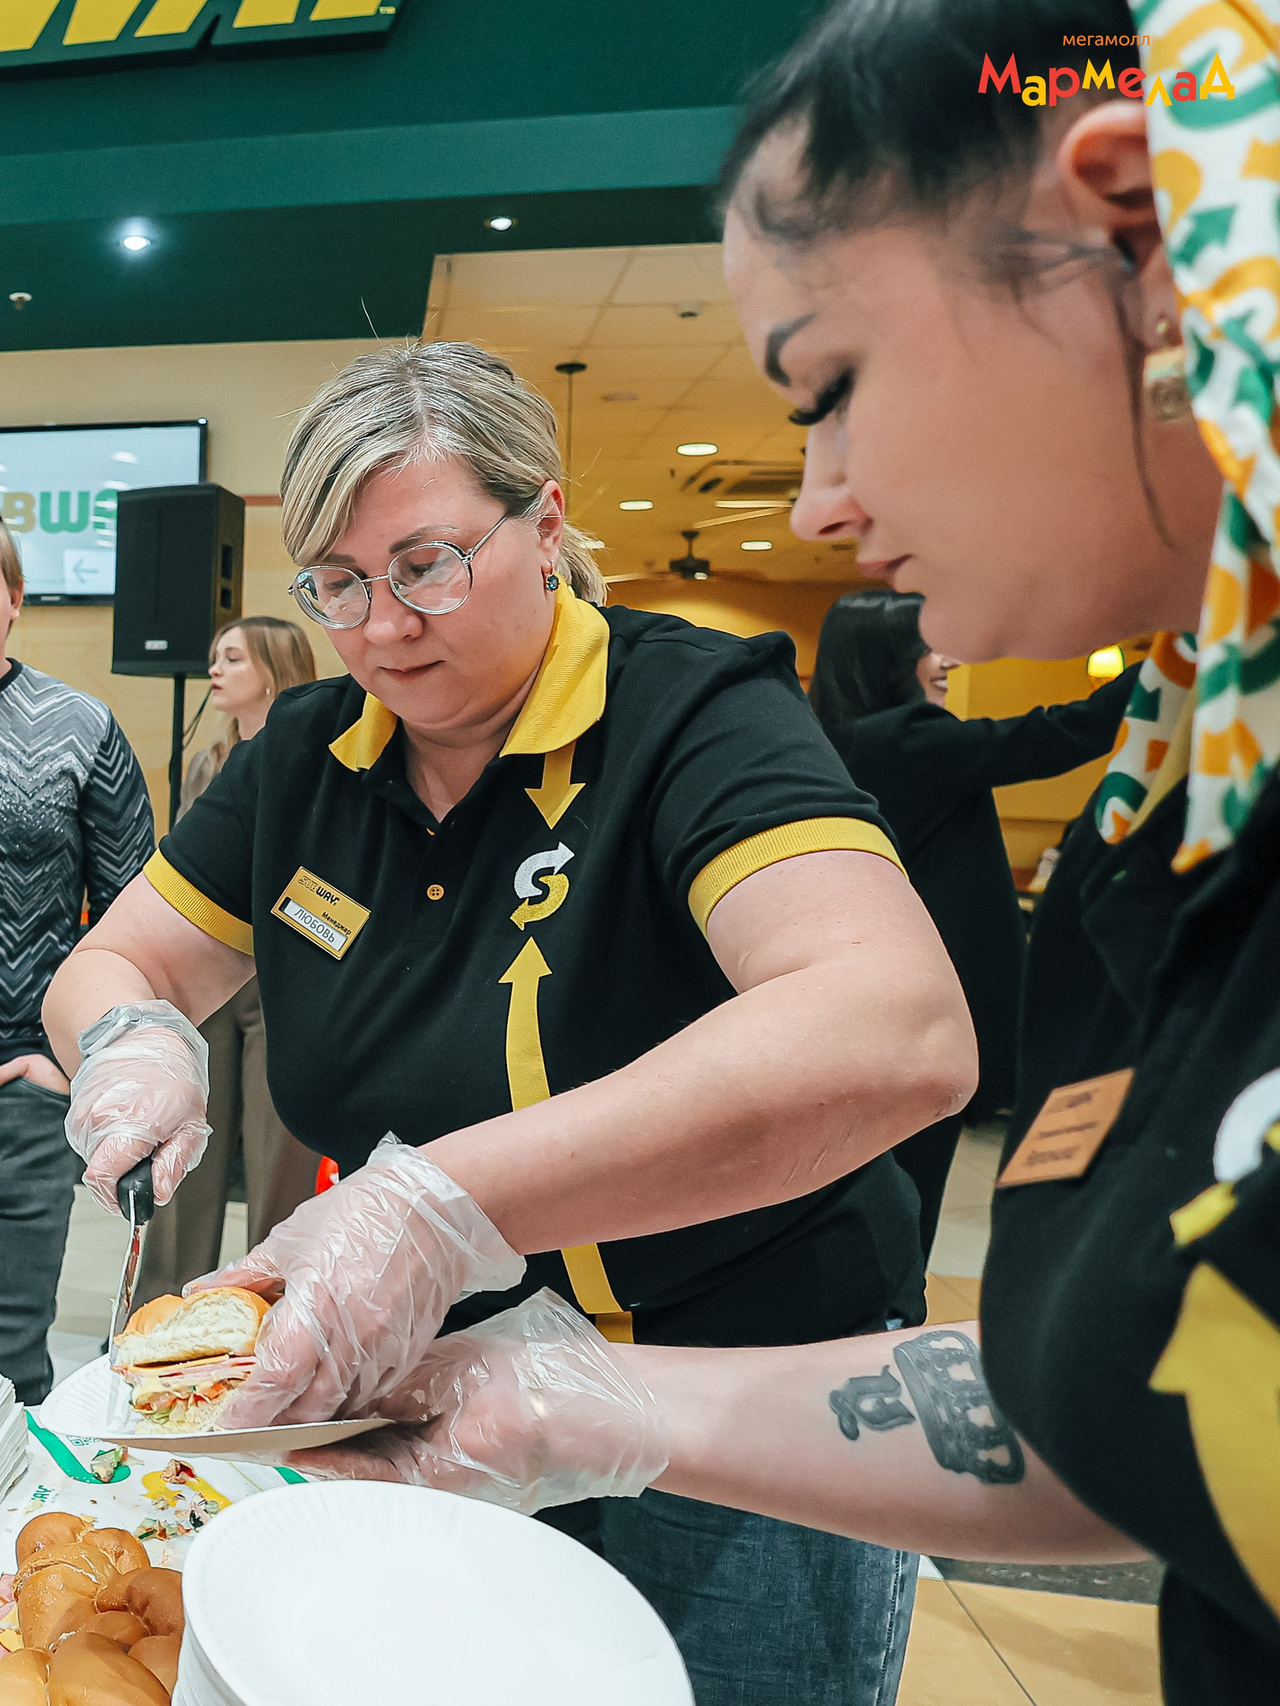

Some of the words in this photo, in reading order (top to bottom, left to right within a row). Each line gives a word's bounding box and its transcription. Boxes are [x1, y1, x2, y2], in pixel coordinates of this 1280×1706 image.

[298, 875, 340, 906] SUBWAY
[294, 909, 335, 943] ЛЮБОВЬ
[321, 911, 352, 936] Менеджер
